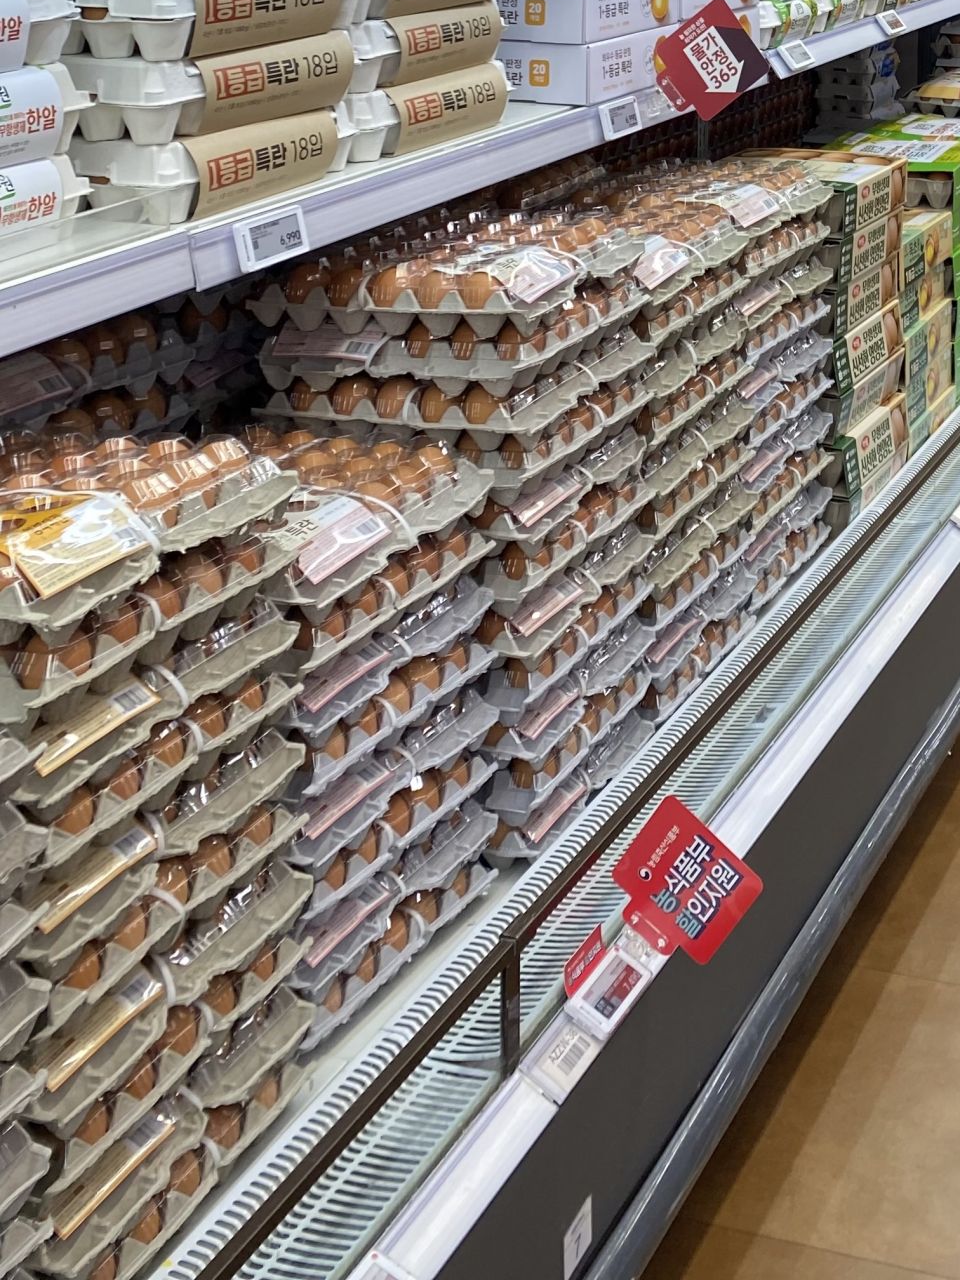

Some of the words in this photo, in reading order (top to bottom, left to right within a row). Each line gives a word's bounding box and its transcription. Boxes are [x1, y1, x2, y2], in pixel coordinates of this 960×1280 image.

[528, 3, 541, 13] 20
[405, 24, 441, 56] 1등급
[440, 21, 464, 44] 특란
[466, 16, 491, 39] 18입
[690, 32, 718, 61] 물가
[214, 62, 264, 101] 1등급
[265, 58, 299, 86] 특란
[303, 51, 338, 79] 18입
[532, 64, 546, 74] 20
[700, 47, 728, 76] 안정
[711, 63, 738, 89] 365
[404, 93, 442, 126] 1등급
[442, 88, 467, 112] 특란
[469, 81, 496, 104] 18입
[26, 105, 57, 133] 한알
[207, 149, 254, 191] 1등급
[256, 143, 287, 172] 특란
[291, 132, 323, 163] 18입
[28, 192, 57, 220] 한알
[280, 230, 302, 245] 6,990
[650, 833, 713, 914] 농식품부
[675, 857, 741, 938] 할인지원
